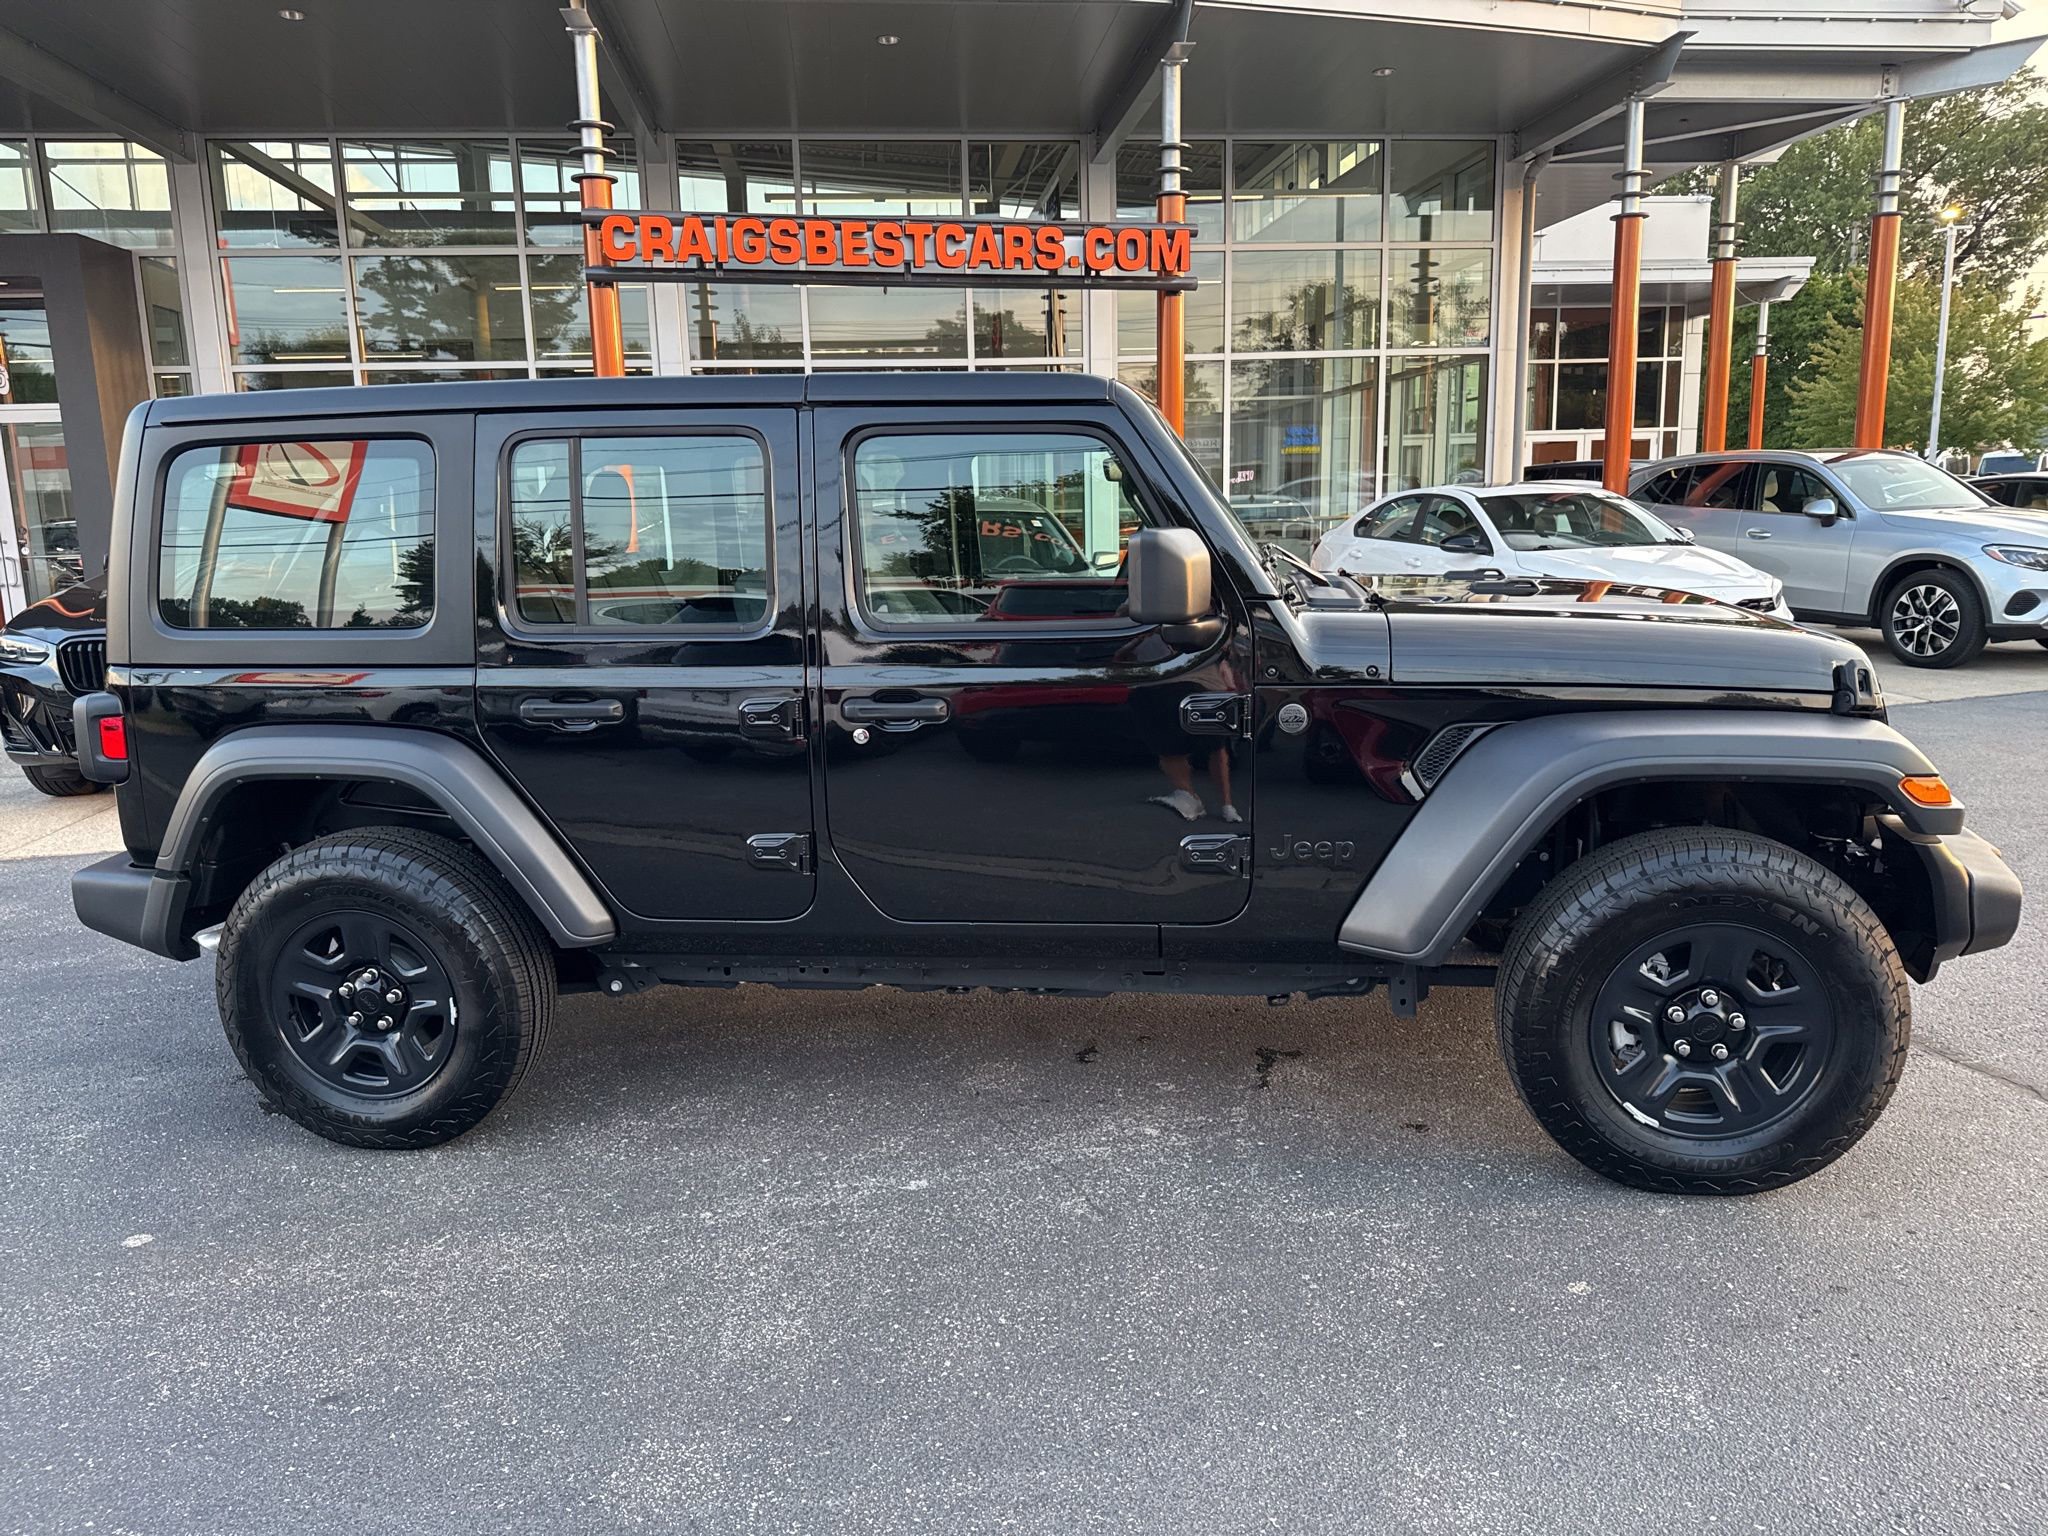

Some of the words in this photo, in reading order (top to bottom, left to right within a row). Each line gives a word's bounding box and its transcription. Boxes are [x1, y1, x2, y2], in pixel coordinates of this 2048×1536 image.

[600, 214, 1192, 273] CRAIGSBESTCARS.COM
[1269, 833, 1355, 865] Jeep
[1681, 895, 1820, 934] NEXEN
